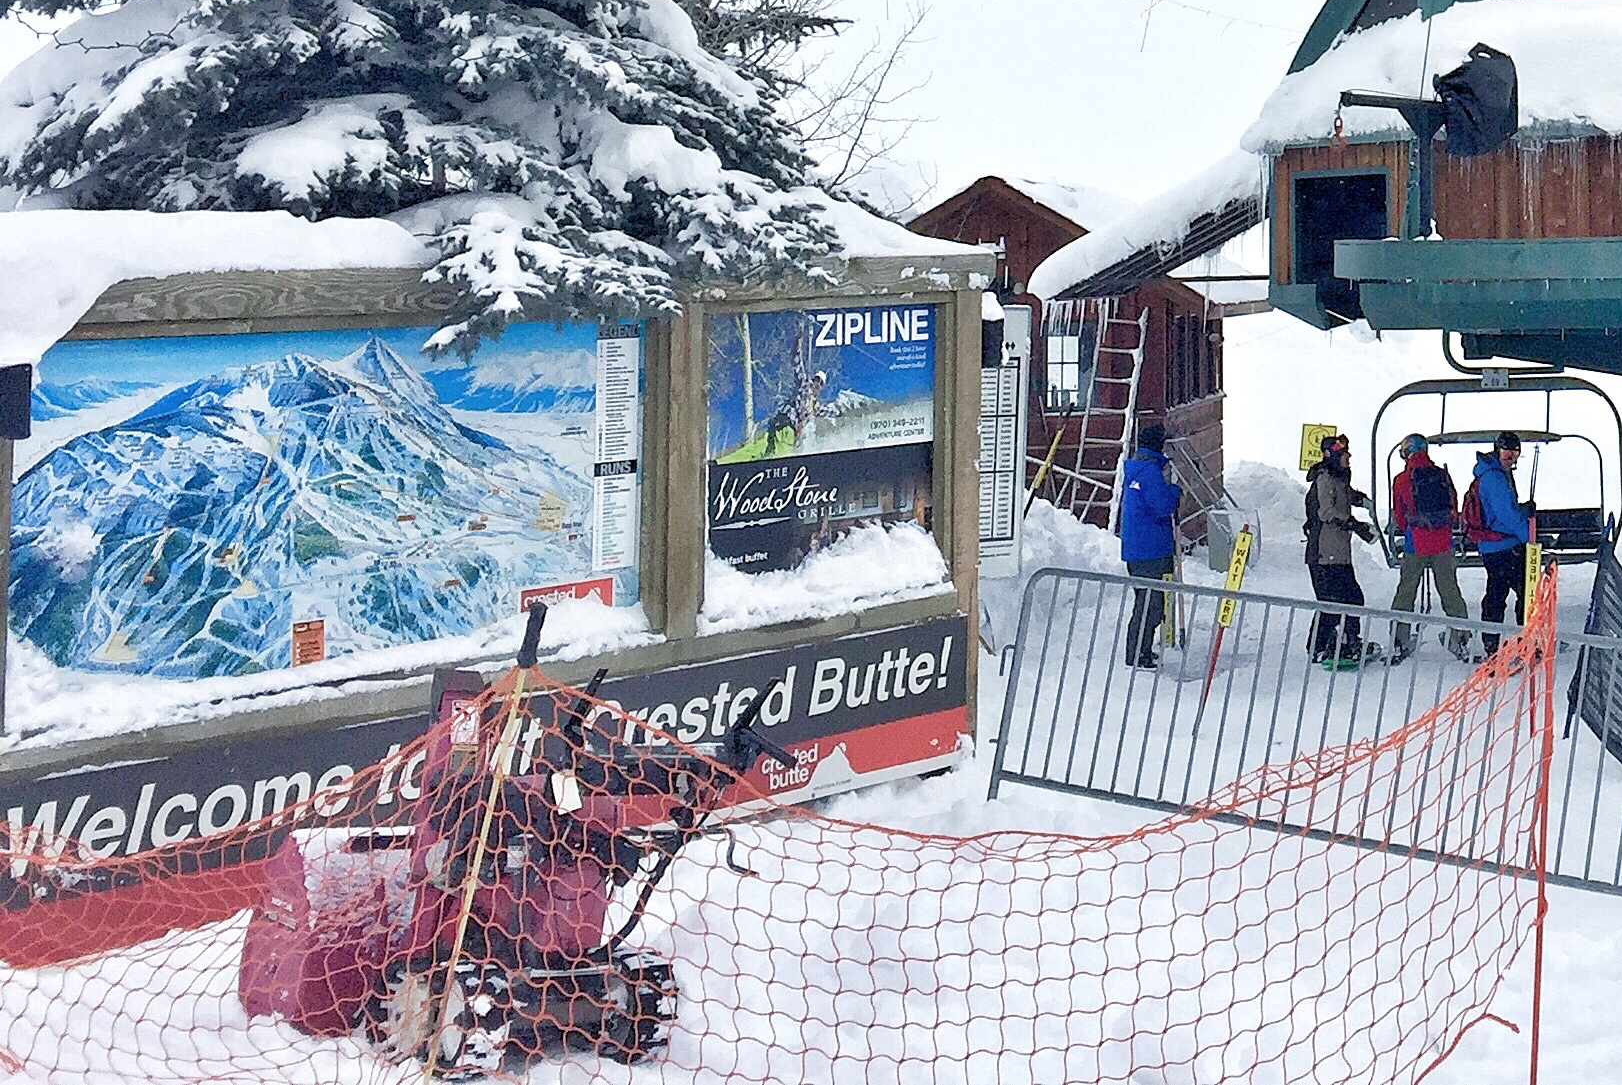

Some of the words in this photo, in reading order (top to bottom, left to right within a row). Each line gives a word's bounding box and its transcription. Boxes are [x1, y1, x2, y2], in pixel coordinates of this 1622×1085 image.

[815, 309, 929, 347] ZIPLINE
[600, 461, 632, 475] RUNS
[765, 467, 788, 478] THE
[797, 502, 856, 520] GRILLE
[745, 551, 768, 563] buffet
[1232, 548, 1246, 582] WAIT
[5, 762, 354, 879] Welcome
[808, 635, 953, 717] Butte!
[761, 743, 819, 774] creted
[769, 762, 810, 790] butte
